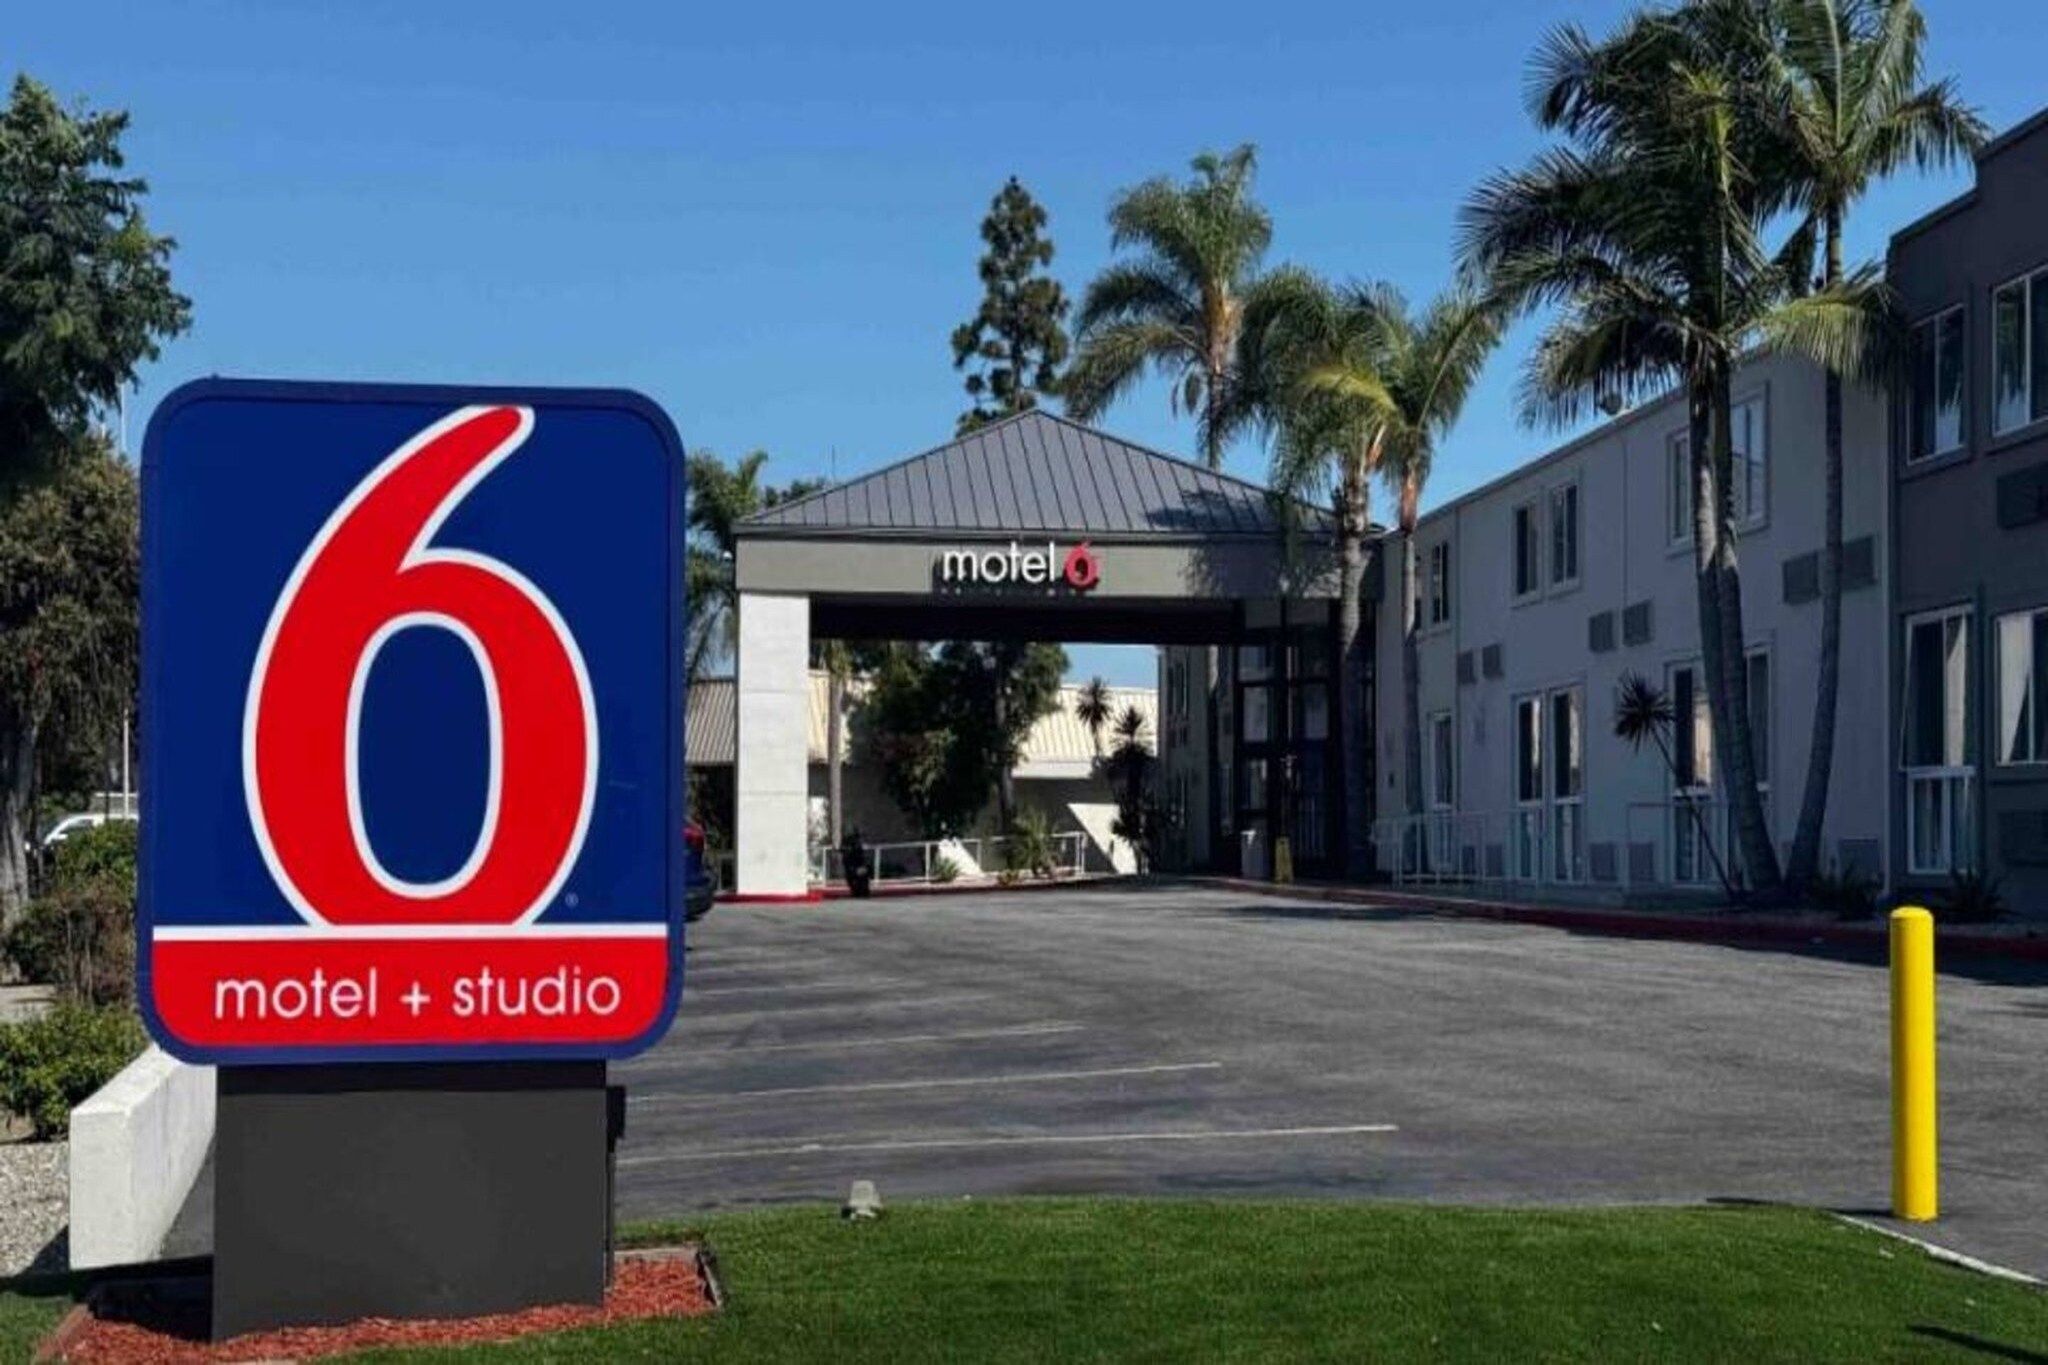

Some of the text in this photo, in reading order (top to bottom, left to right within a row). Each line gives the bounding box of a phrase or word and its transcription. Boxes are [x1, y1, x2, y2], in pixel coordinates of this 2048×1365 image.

[942, 538, 1099, 586] motel 6
[243, 405, 599, 926] 6
[215, 967, 377, 1019] motel
[453, 965, 621, 1016] studio
